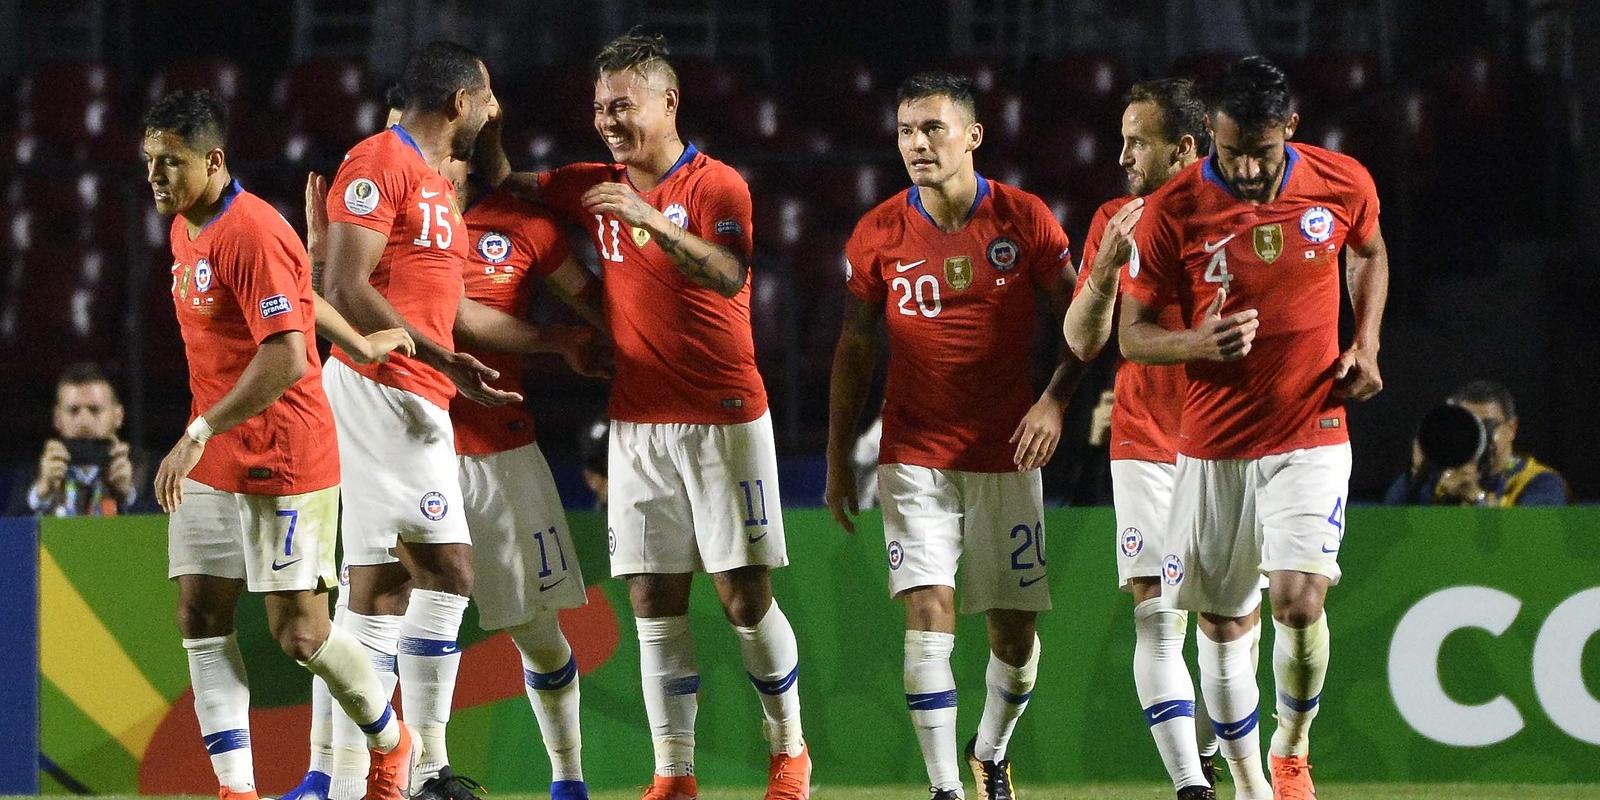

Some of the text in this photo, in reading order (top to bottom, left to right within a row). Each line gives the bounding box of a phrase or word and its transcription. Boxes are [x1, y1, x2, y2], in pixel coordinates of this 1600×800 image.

[413, 202, 452, 250] 15
[594, 214, 624, 262] 11
[1204, 247, 1233, 293] 4
[892, 274, 942, 317] 20
[739, 479, 768, 526] 11
[1327, 496, 1342, 544] 4
[275, 510, 298, 556] 7
